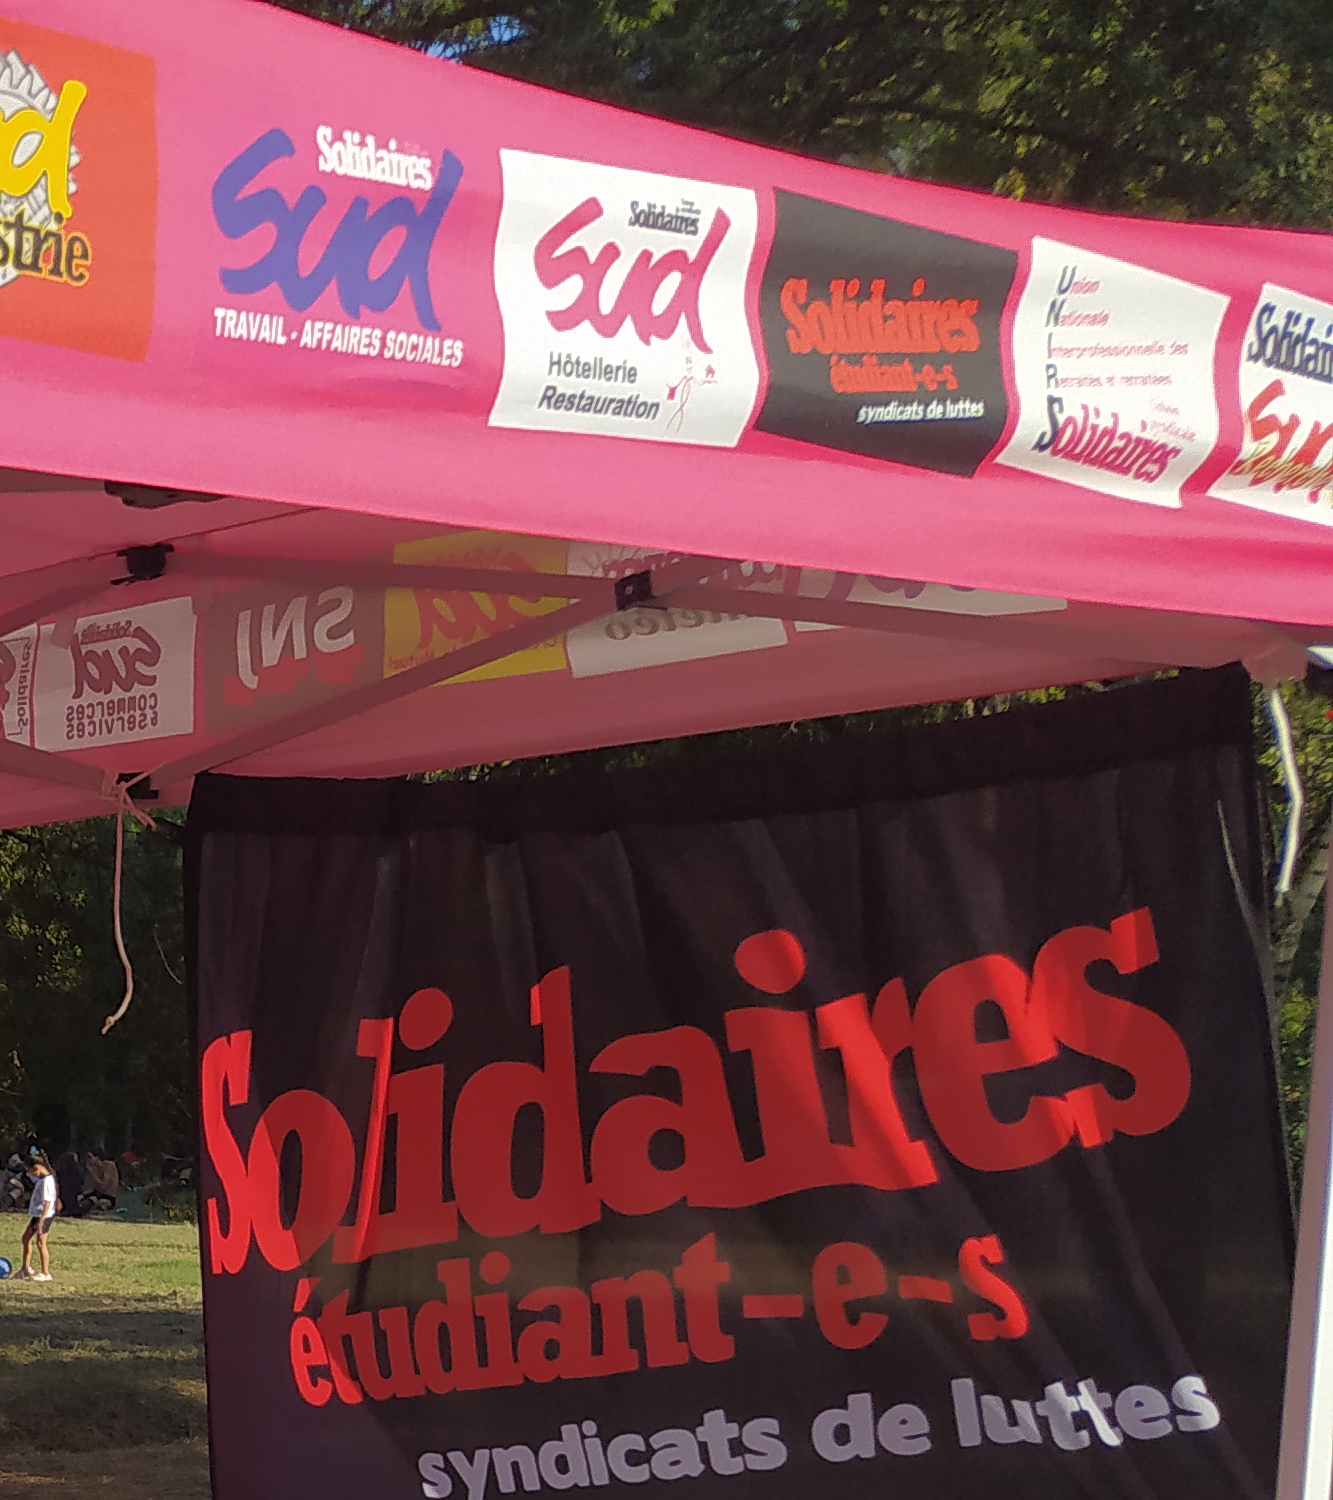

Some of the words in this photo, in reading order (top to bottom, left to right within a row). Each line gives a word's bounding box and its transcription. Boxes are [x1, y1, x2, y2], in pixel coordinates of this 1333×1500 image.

[316, 125, 433, 191] Solidaires
[212, 128, 464, 332] Sud
[628, 200, 699, 236] Solidaires
[534, 196, 731, 354] Sud
[1057, 264, 1101, 295] Union
[214, 308, 287, 348] TRAVAIL
[299, 324, 381, 360] AFFAIRES
[384, 332, 463, 368] SOCIALES
[780, 276, 981, 356] Solidaires
[548, 351, 637, 384] Hôtellerie
[537, 385, 660, 420] Restauration
[856, 399, 924, 425] syndicats
[927, 401, 946, 420] de
[948, 399, 985, 420] luttes
[1032, 394, 1183, 484] Solidaires
[202, 907, 1192, 1277] Solidaires
[812, 1392, 932, 1465] de
[954, 1372, 1223, 1452] luttes
